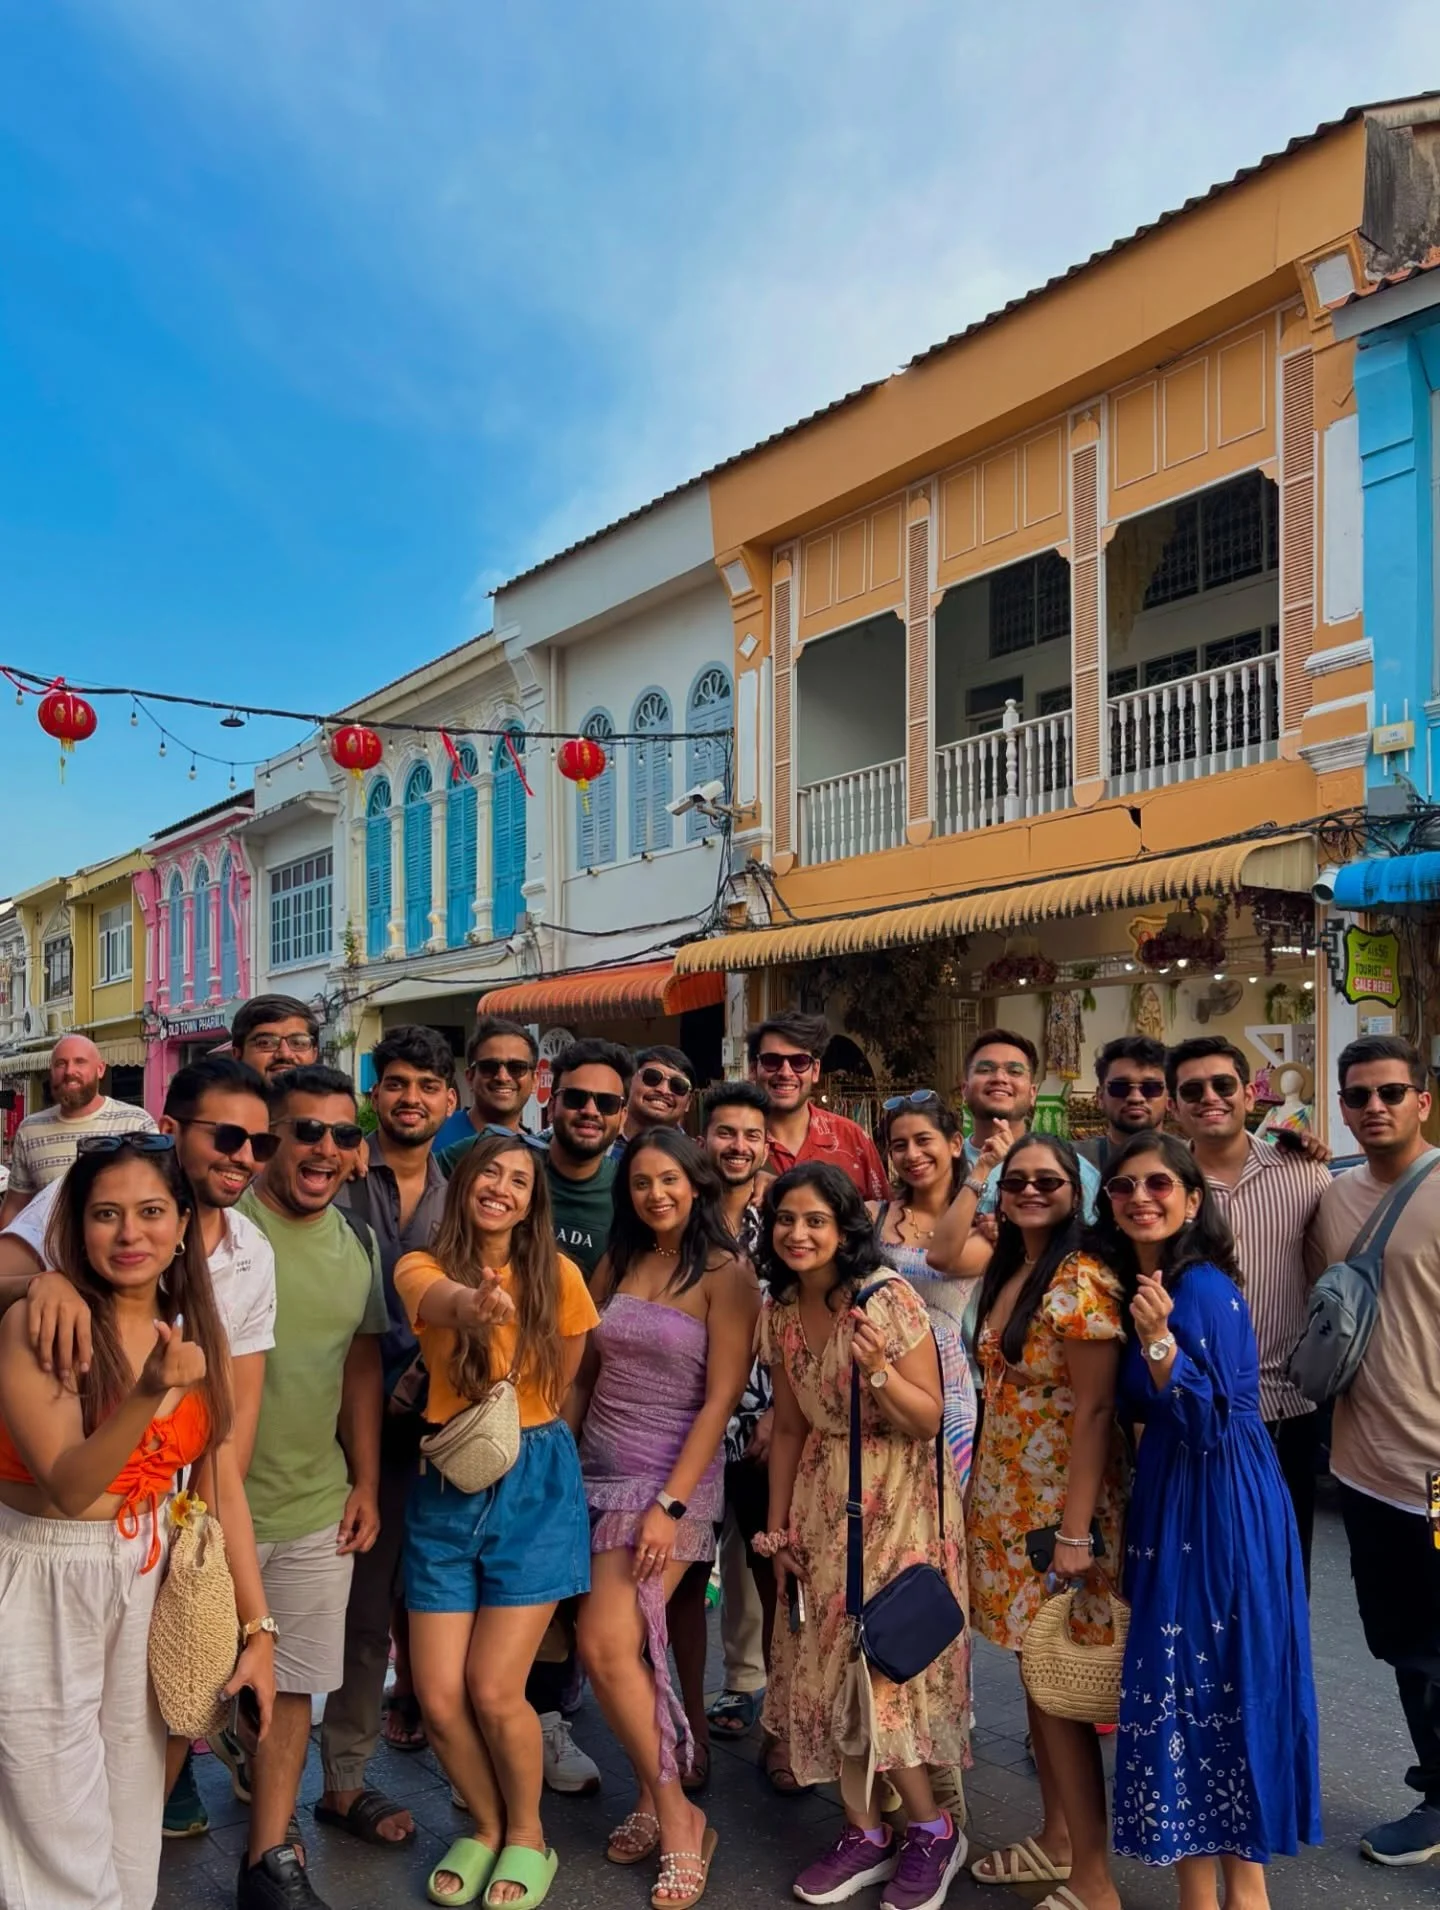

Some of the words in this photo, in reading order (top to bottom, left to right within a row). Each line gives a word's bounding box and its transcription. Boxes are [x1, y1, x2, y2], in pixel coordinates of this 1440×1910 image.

[1355, 963, 1382, 977] TOURIST
[1355, 978, 1372, 992] SALE
[168, 1023, 179, 1036] OLD
[181, 1020, 197, 1034] TOWN
